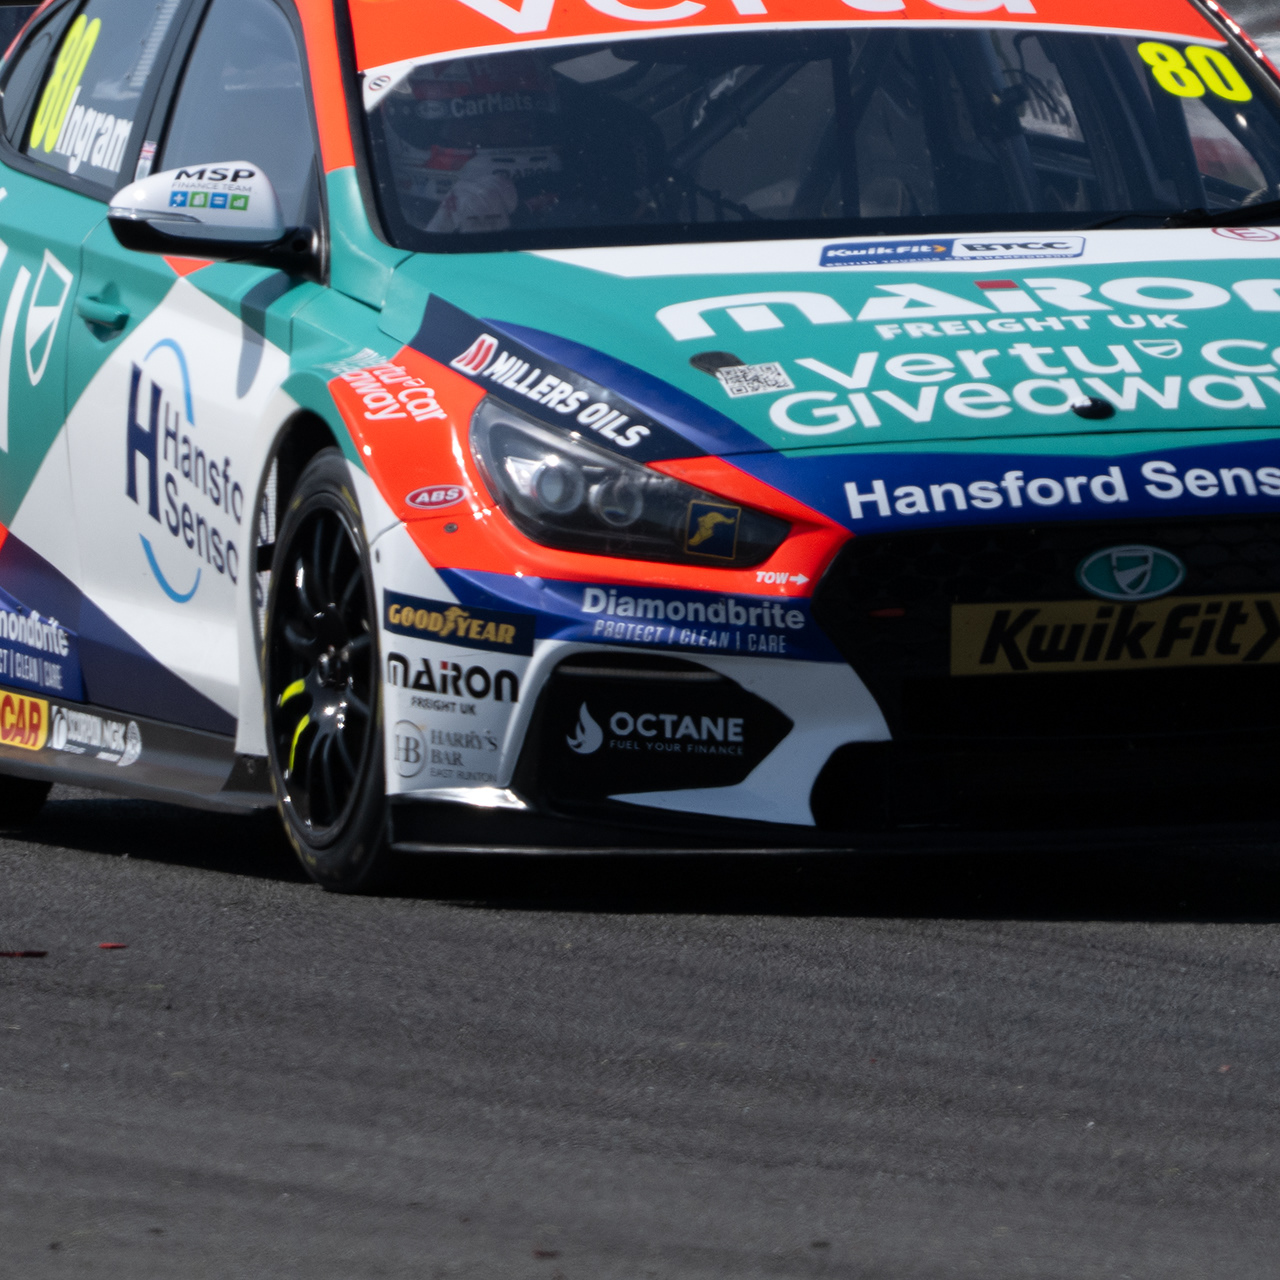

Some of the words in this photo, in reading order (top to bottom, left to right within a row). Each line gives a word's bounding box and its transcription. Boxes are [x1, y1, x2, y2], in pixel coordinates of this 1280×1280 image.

[1137, 41, 1252, 102] 80
[55, 85, 134, 174] Ingram
[171, 181, 219, 190] FINANCE
[221, 183, 253, 193] TEAM
[174, 167, 256, 183] MSP
[826, 246, 894, 258] Kwik
[896, 244, 932, 254] Fit
[961, 241, 1073, 253] BTCC
[874, 316, 1091, 341] FREIGHT
[1106, 314, 1189, 330] UK
[793, 342, 1143, 390] Vertu
[398, 387, 448, 422] Car
[483, 351, 589, 414] MILLERS
[576, 402, 651, 447] OILS
[415, 489, 460, 503] ABS
[844, 466, 1129, 519] Hansford
[756, 571, 789, 585] TOW
[582, 588, 805, 630] Diamondbrite
[387, 603, 516, 645] GOODYEAR
[593, 620, 665, 644] PROTECT
[679, 628, 730, 649] CLEAN
[748, 634, 787, 654] CARE
[410, 696, 457, 713] FREIGHT
[459, 702, 477, 716] UK
[609, 711, 745, 742] OCTANE
[430, 749, 465, 767] BAR
[609, 738, 641, 751] FUEL
[646, 741, 682, 753] YOUR
[686, 743, 745, 755] FINANCE
